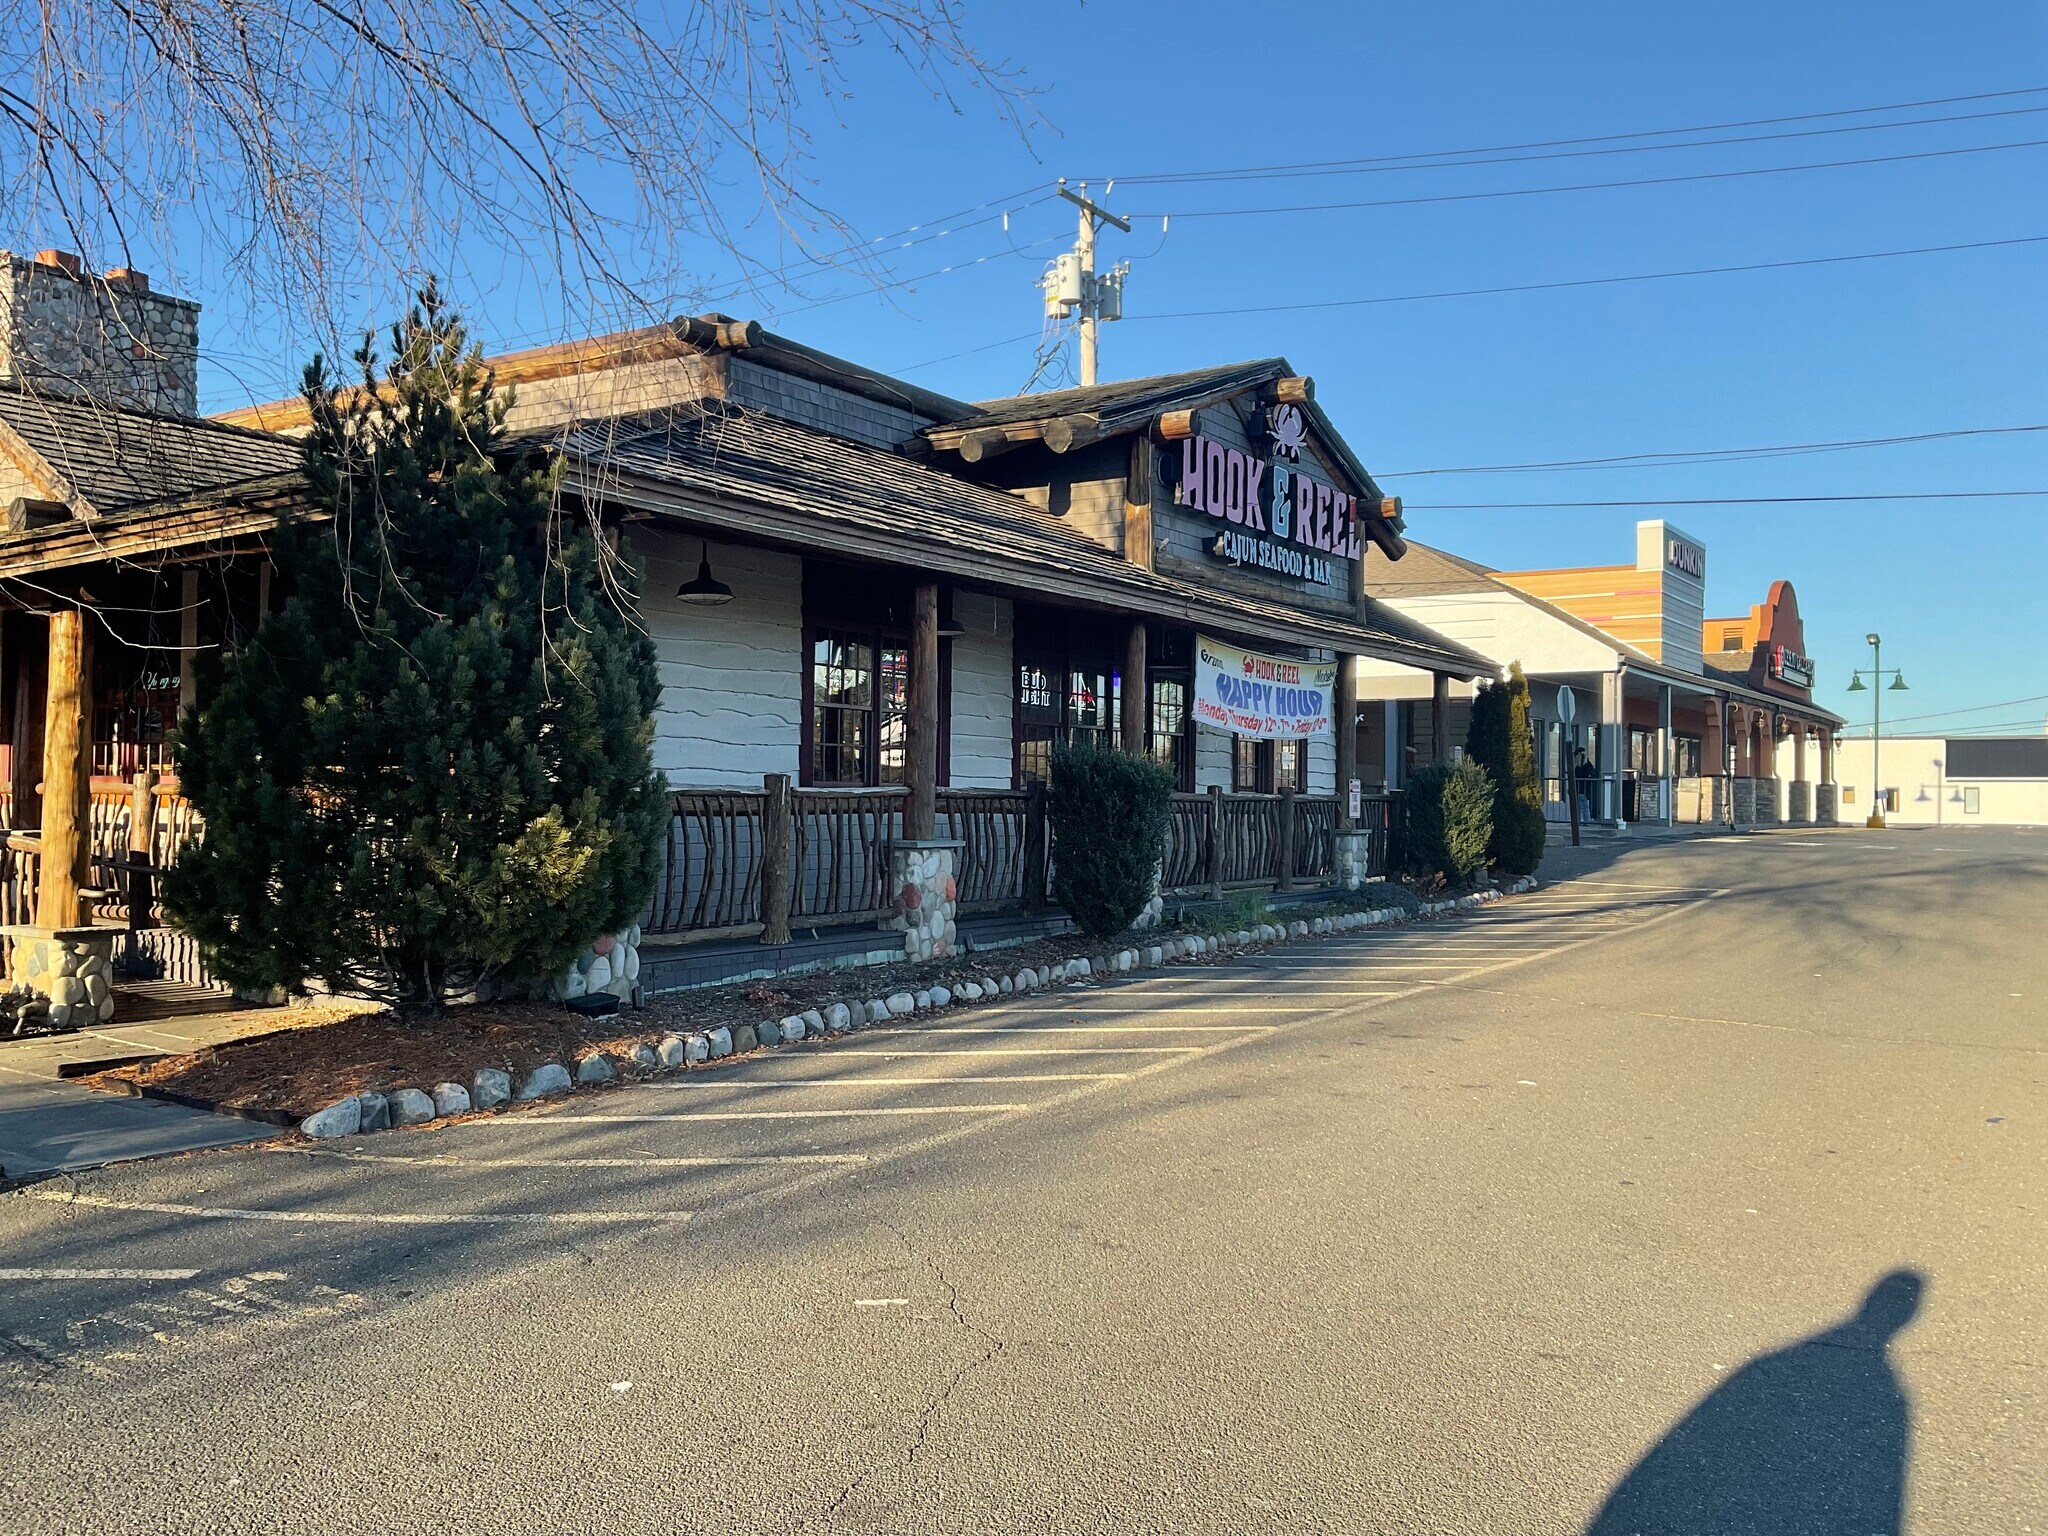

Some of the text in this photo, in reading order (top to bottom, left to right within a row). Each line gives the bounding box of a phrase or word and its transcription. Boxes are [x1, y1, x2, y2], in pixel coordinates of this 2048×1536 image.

[1182, 436, 1361, 560] HOOK & REEL
[1224, 530, 1332, 585] CAJUN SEAFOOD & BAR
[1021, 671, 1047, 690] BUD
[1215, 672, 1323, 717] HAPPY HOUR
[1256, 659, 1300, 685] HOOK & REEL
